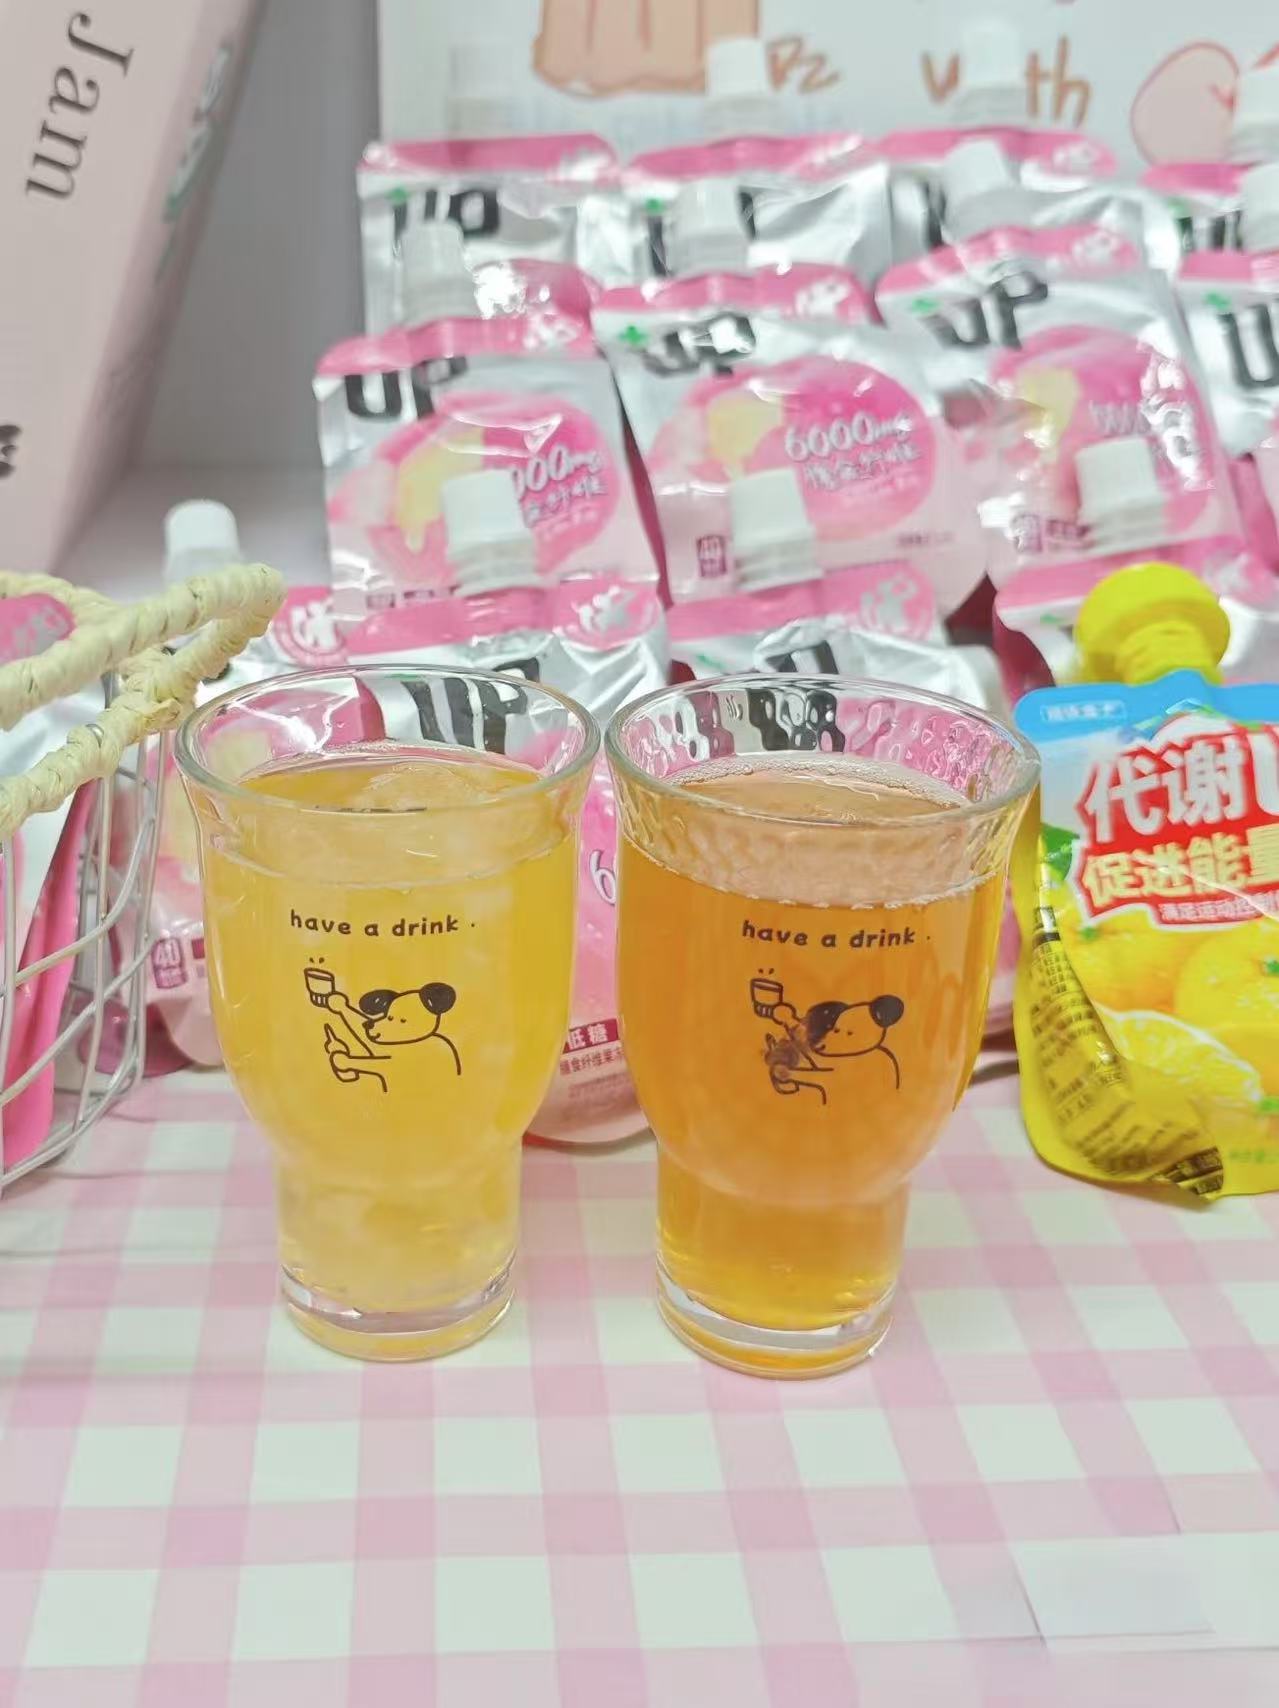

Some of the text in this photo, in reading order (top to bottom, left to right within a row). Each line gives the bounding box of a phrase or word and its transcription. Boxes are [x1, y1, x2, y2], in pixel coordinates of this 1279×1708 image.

[24, 11, 135, 201] Jam
[290, 909, 351, 935] have
[364, 923, 379, 936] a
[392, 915, 458, 936] drink
[742, 920, 808, 946] have
[821, 933, 836, 947] a
[850, 927, 915, 948] drink
